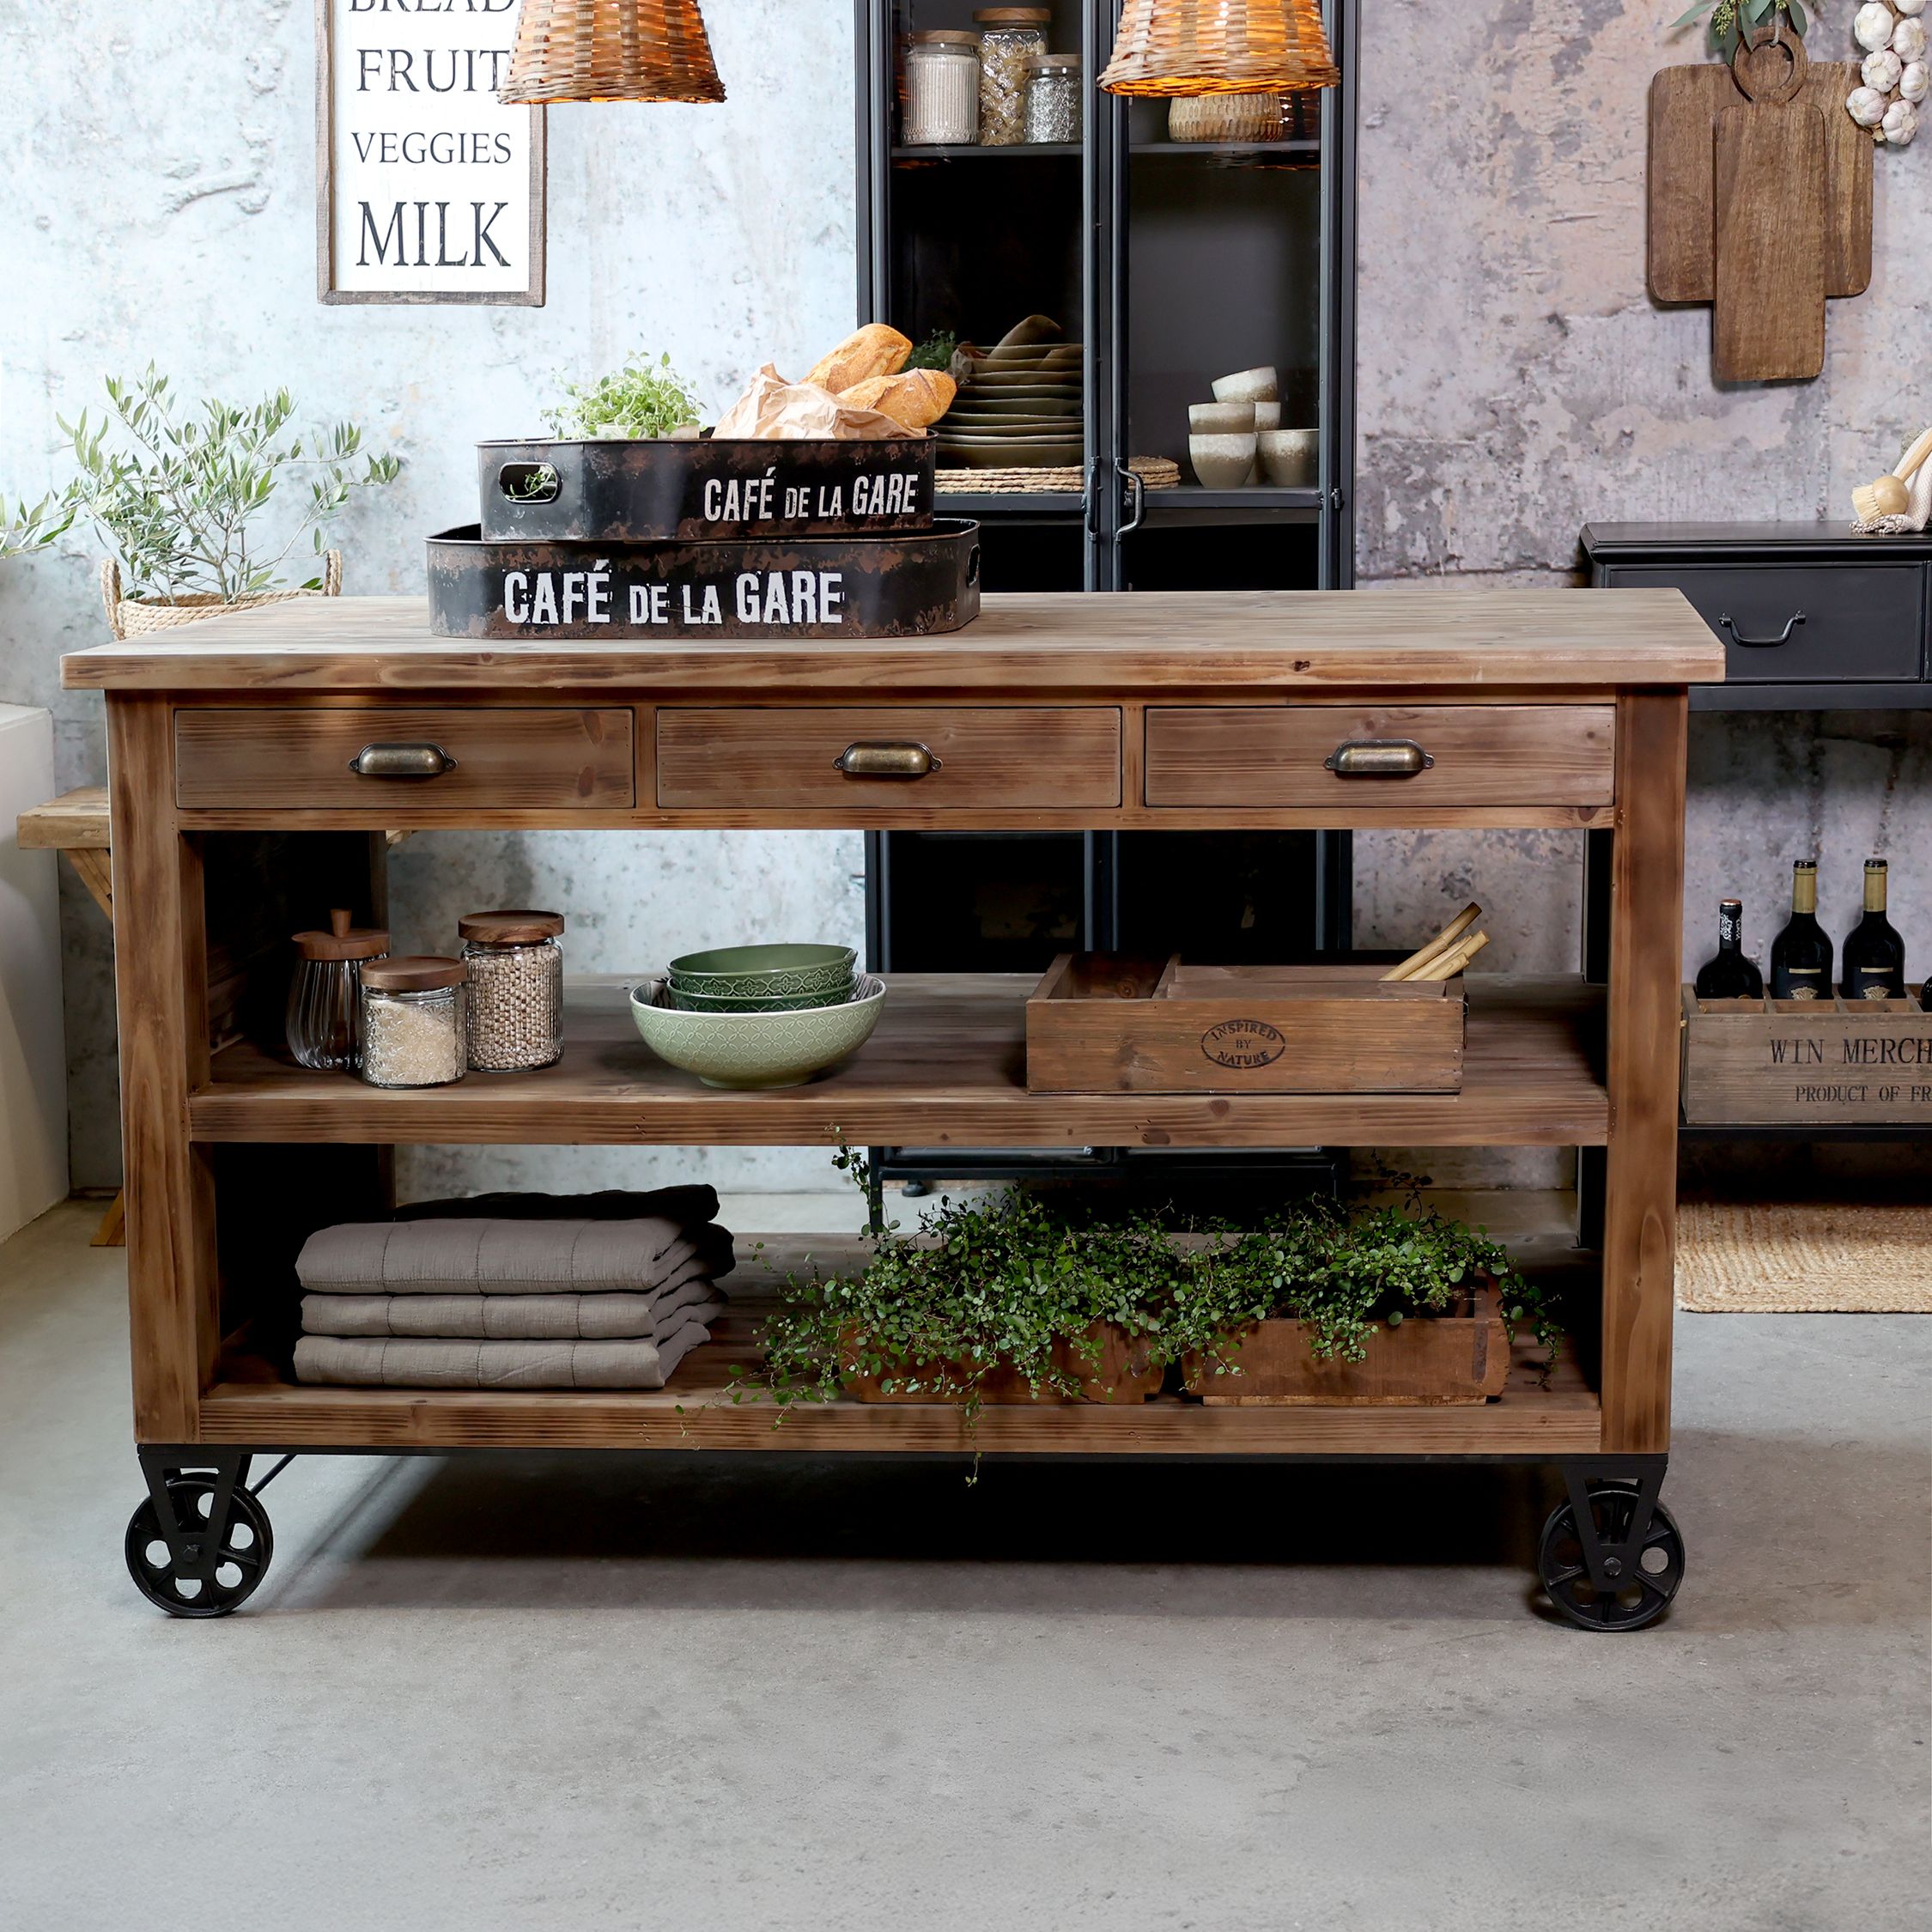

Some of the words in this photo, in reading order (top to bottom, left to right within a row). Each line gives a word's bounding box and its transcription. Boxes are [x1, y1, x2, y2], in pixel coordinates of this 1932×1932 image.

[356, 49, 511, 93] FRUIT
[351, 132, 512, 163] VEGGIES
[355, 202, 511, 266] MILK
[704, 466, 775, 521] CAFÉ
[785, 487, 811, 519] DE
[818, 486, 842, 517] LA
[853, 473, 920, 514] GARE
[504, 558, 611, 624] CAFÉ
[629, 584, 670, 624] DE
[683, 585, 723, 624] LA
[736, 571, 844, 624] GARE
[1211, 1021, 1277, 1042] INSPIRED
[1236, 1039, 1252, 1049] BY
[1218, 1050, 1270, 1065] NATURE
[1770, 1038, 1826, 1064] WIN
[1843, 1037, 1932, 1064] MERCH
[1795, 1085, 1868, 1103] PRODUCT
[1879, 1085, 1900, 1102] OF
